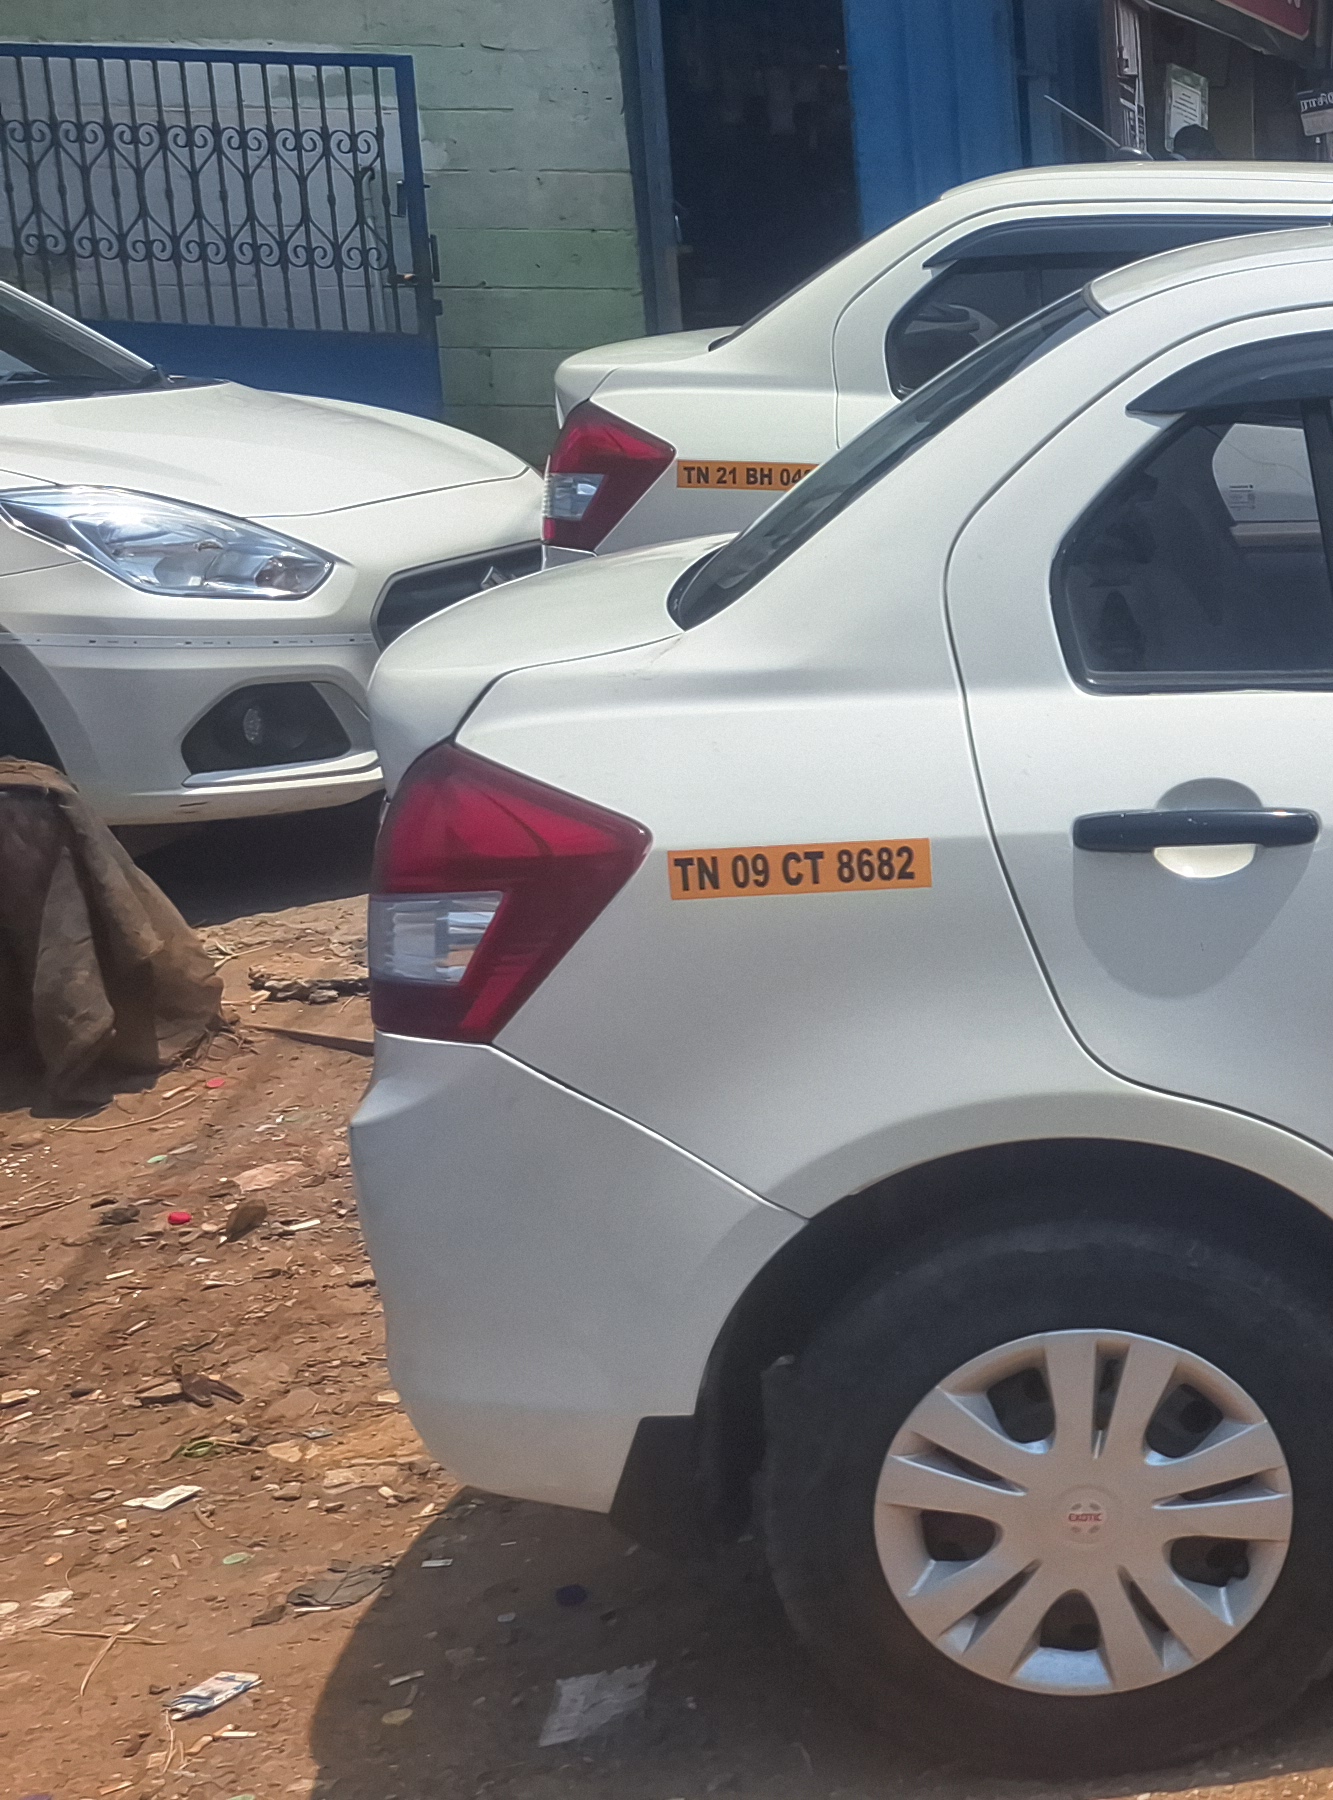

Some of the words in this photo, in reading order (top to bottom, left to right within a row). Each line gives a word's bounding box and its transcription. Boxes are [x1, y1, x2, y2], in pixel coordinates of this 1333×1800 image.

[683, 466, 710, 485] TN
[716, 466, 737, 485] 21
[745, 467, 772, 486] BH
[674, 856, 720, 892] TN
[731, 853, 770, 889] 09
[782, 850, 824, 887] CT
[837, 846, 915, 884] 8682
